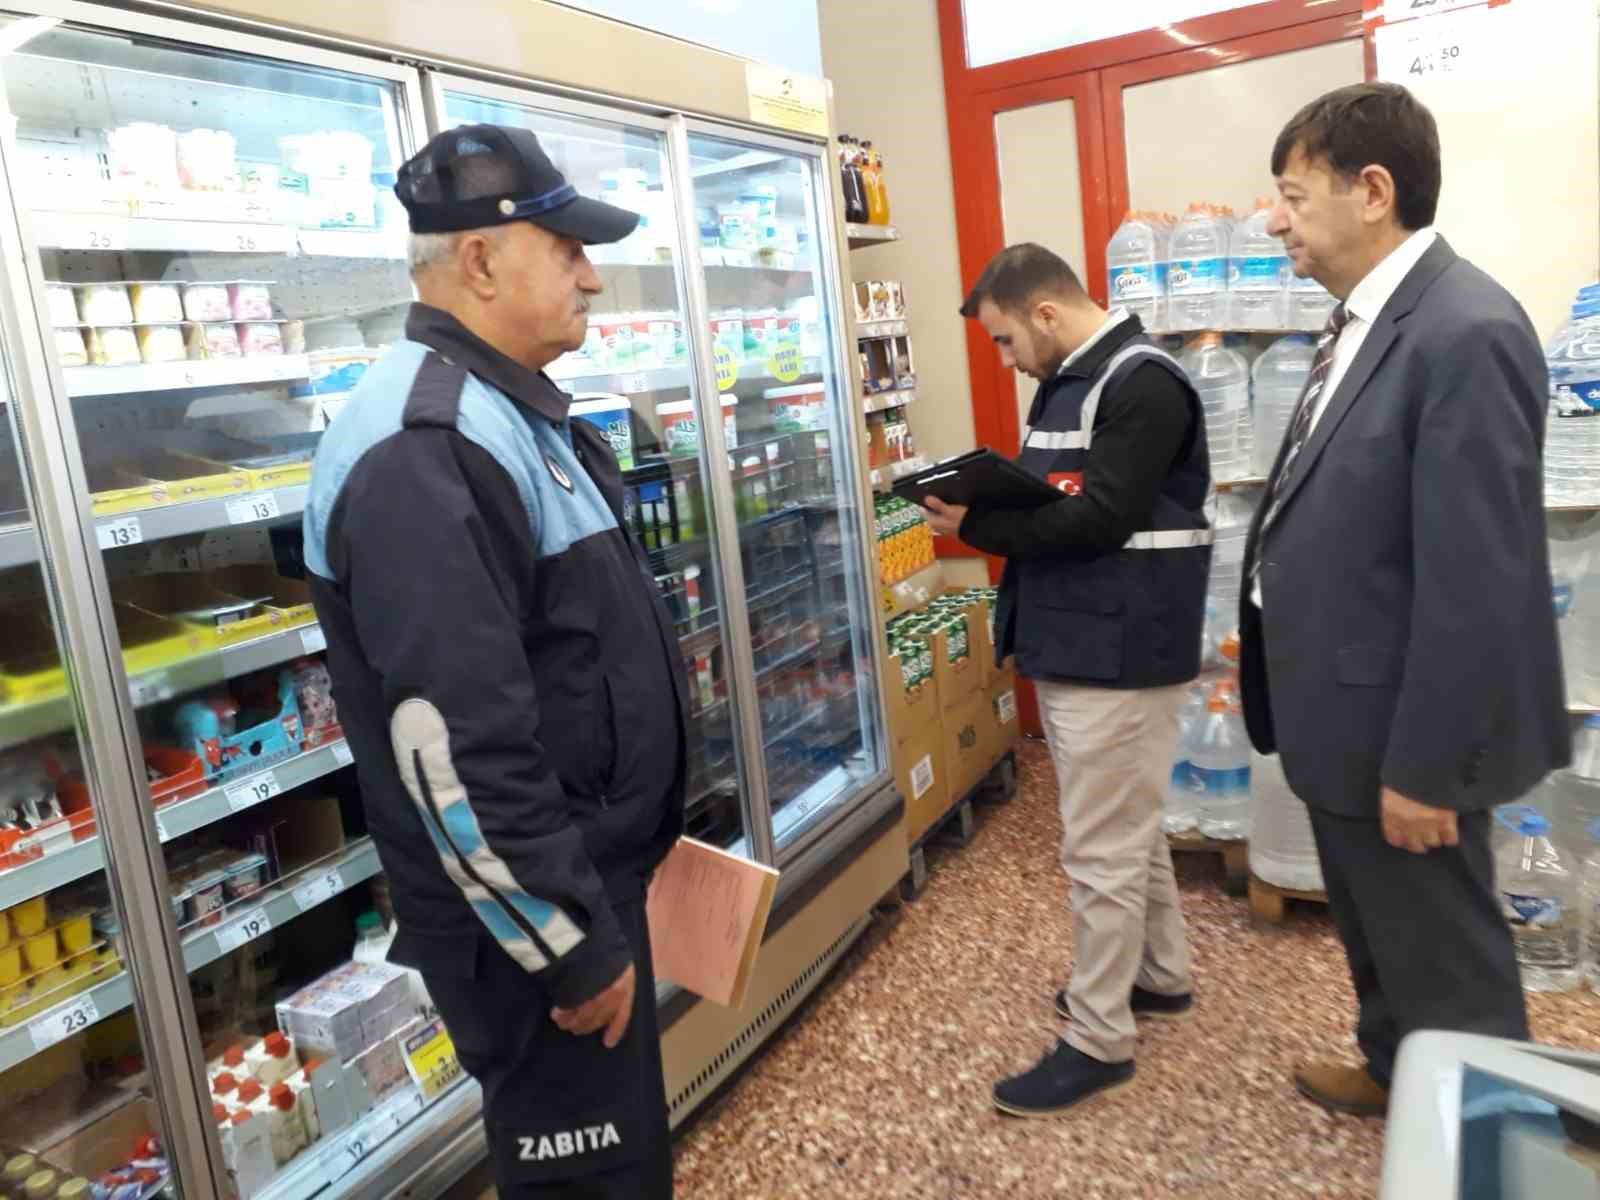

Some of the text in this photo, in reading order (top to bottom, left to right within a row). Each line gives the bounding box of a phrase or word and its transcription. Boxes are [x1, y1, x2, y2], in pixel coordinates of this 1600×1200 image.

[253, 503, 270, 519] 13
[110, 528, 130, 545] 13
[251, 783, 270, 800] 19
[242, 920, 261, 937] 19
[62, 1009, 88, 1033] 23
[517, 1122, 621, 1161] ZABITA
